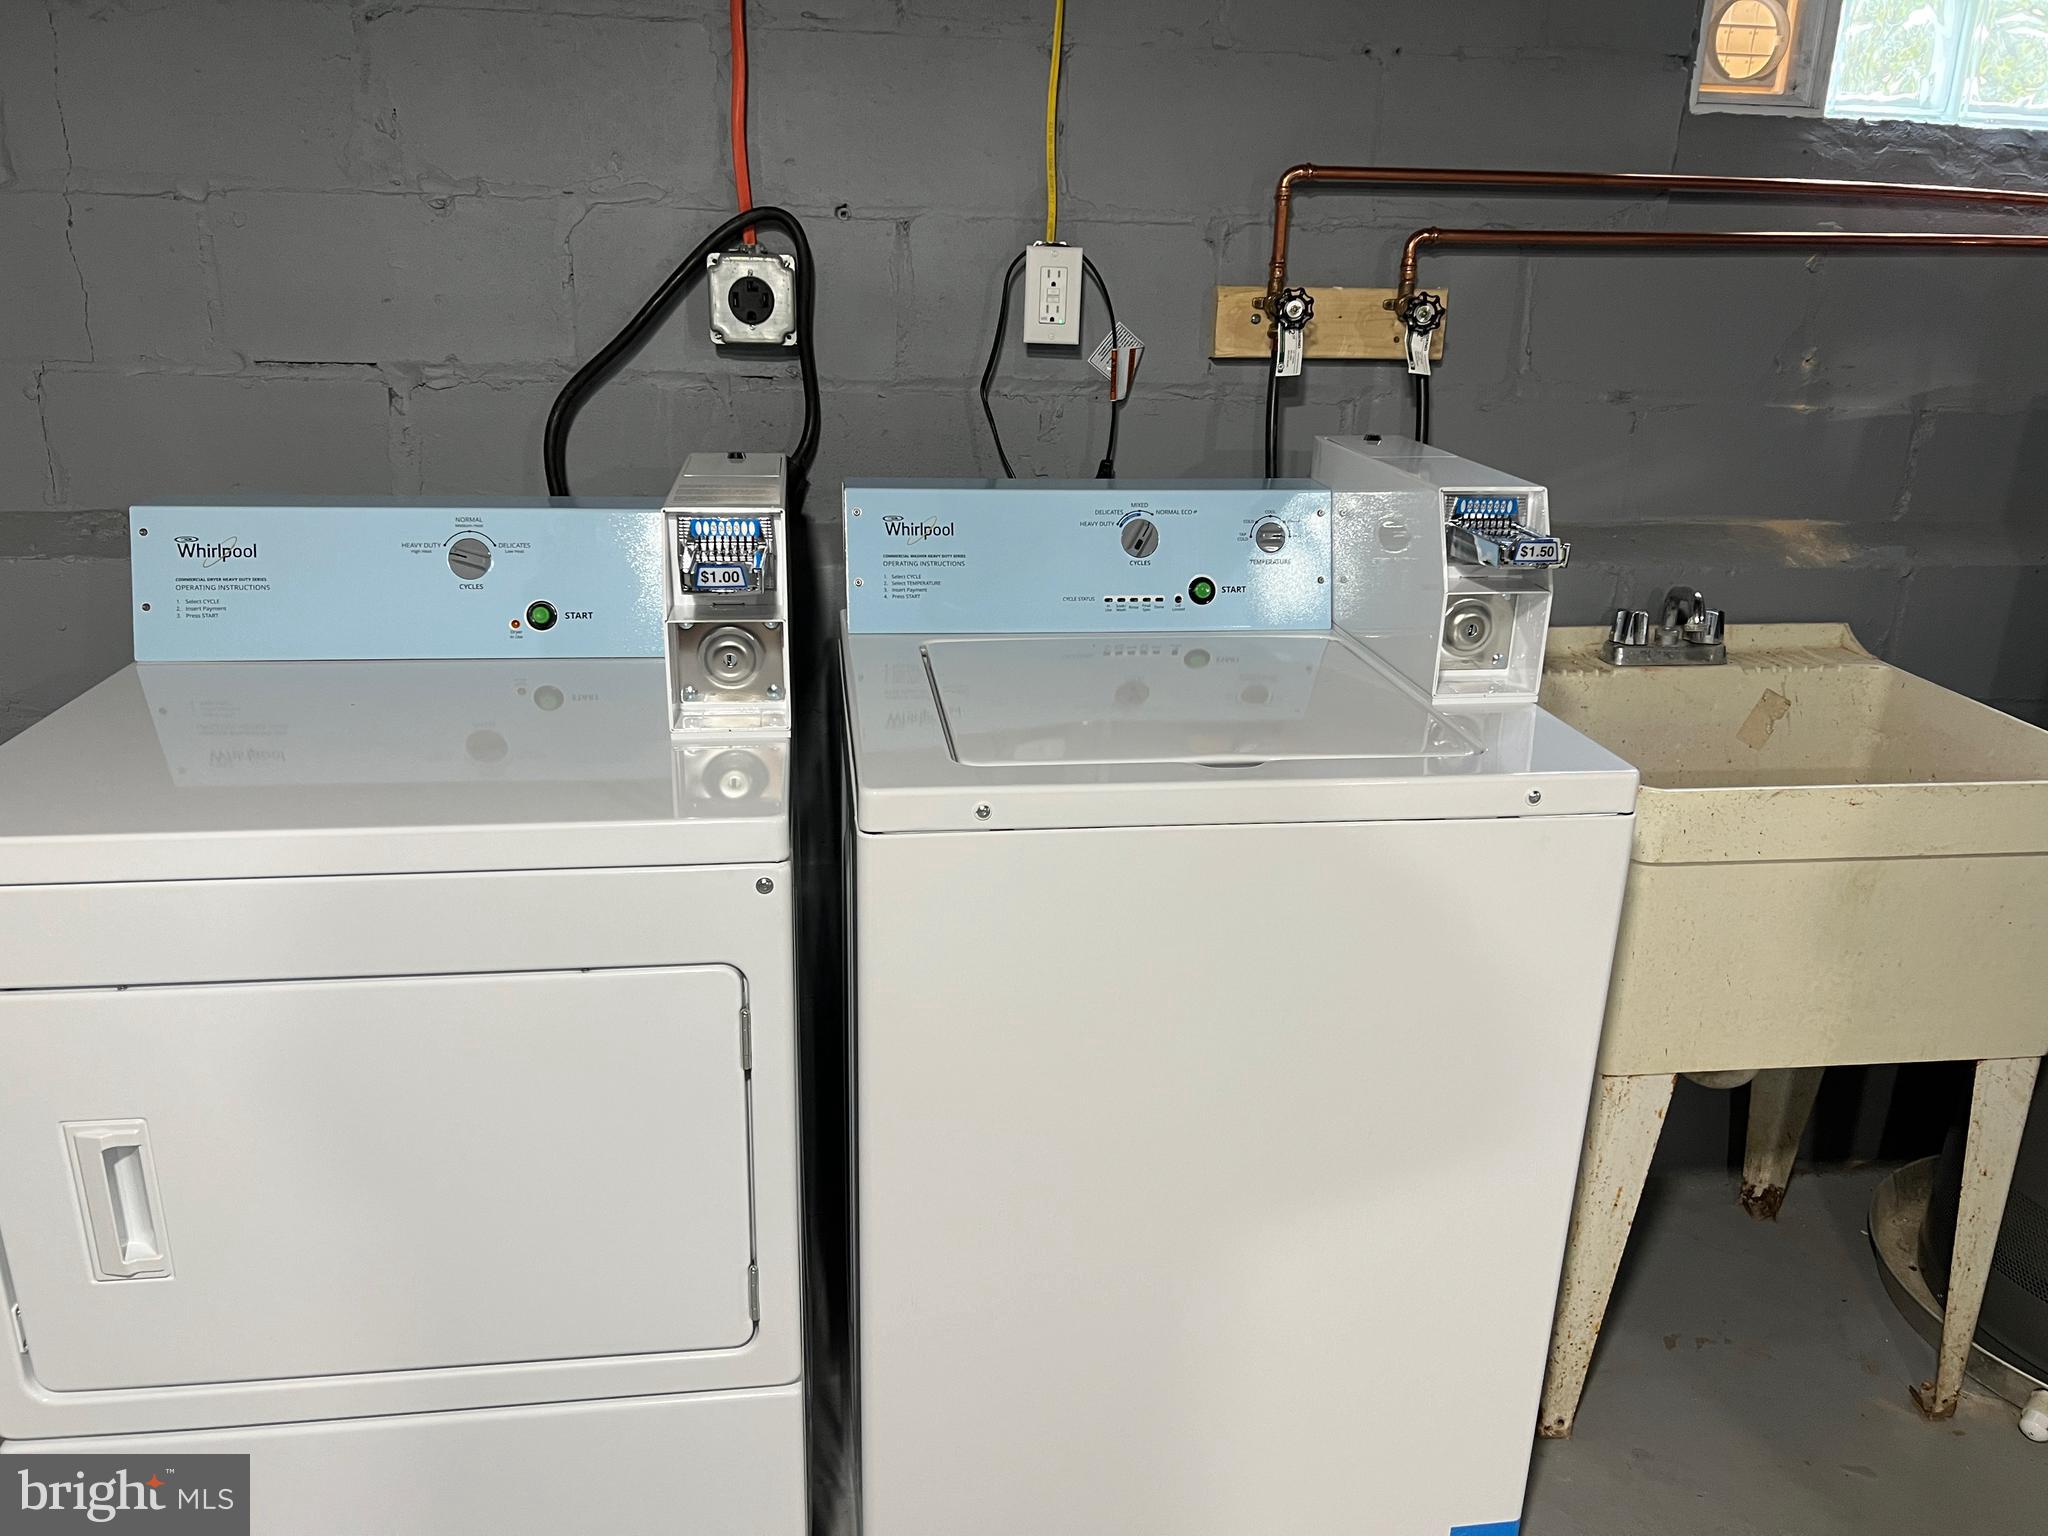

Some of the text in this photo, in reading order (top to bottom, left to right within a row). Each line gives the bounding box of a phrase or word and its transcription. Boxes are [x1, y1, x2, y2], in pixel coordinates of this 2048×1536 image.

[885, 521, 954, 540] Whirlpool
[177, 543, 257, 562] Whirlpool
[1520, 545, 1554, 558] $1.50
[701, 570, 740, 583] $1.00
[565, 611, 593, 620] START
